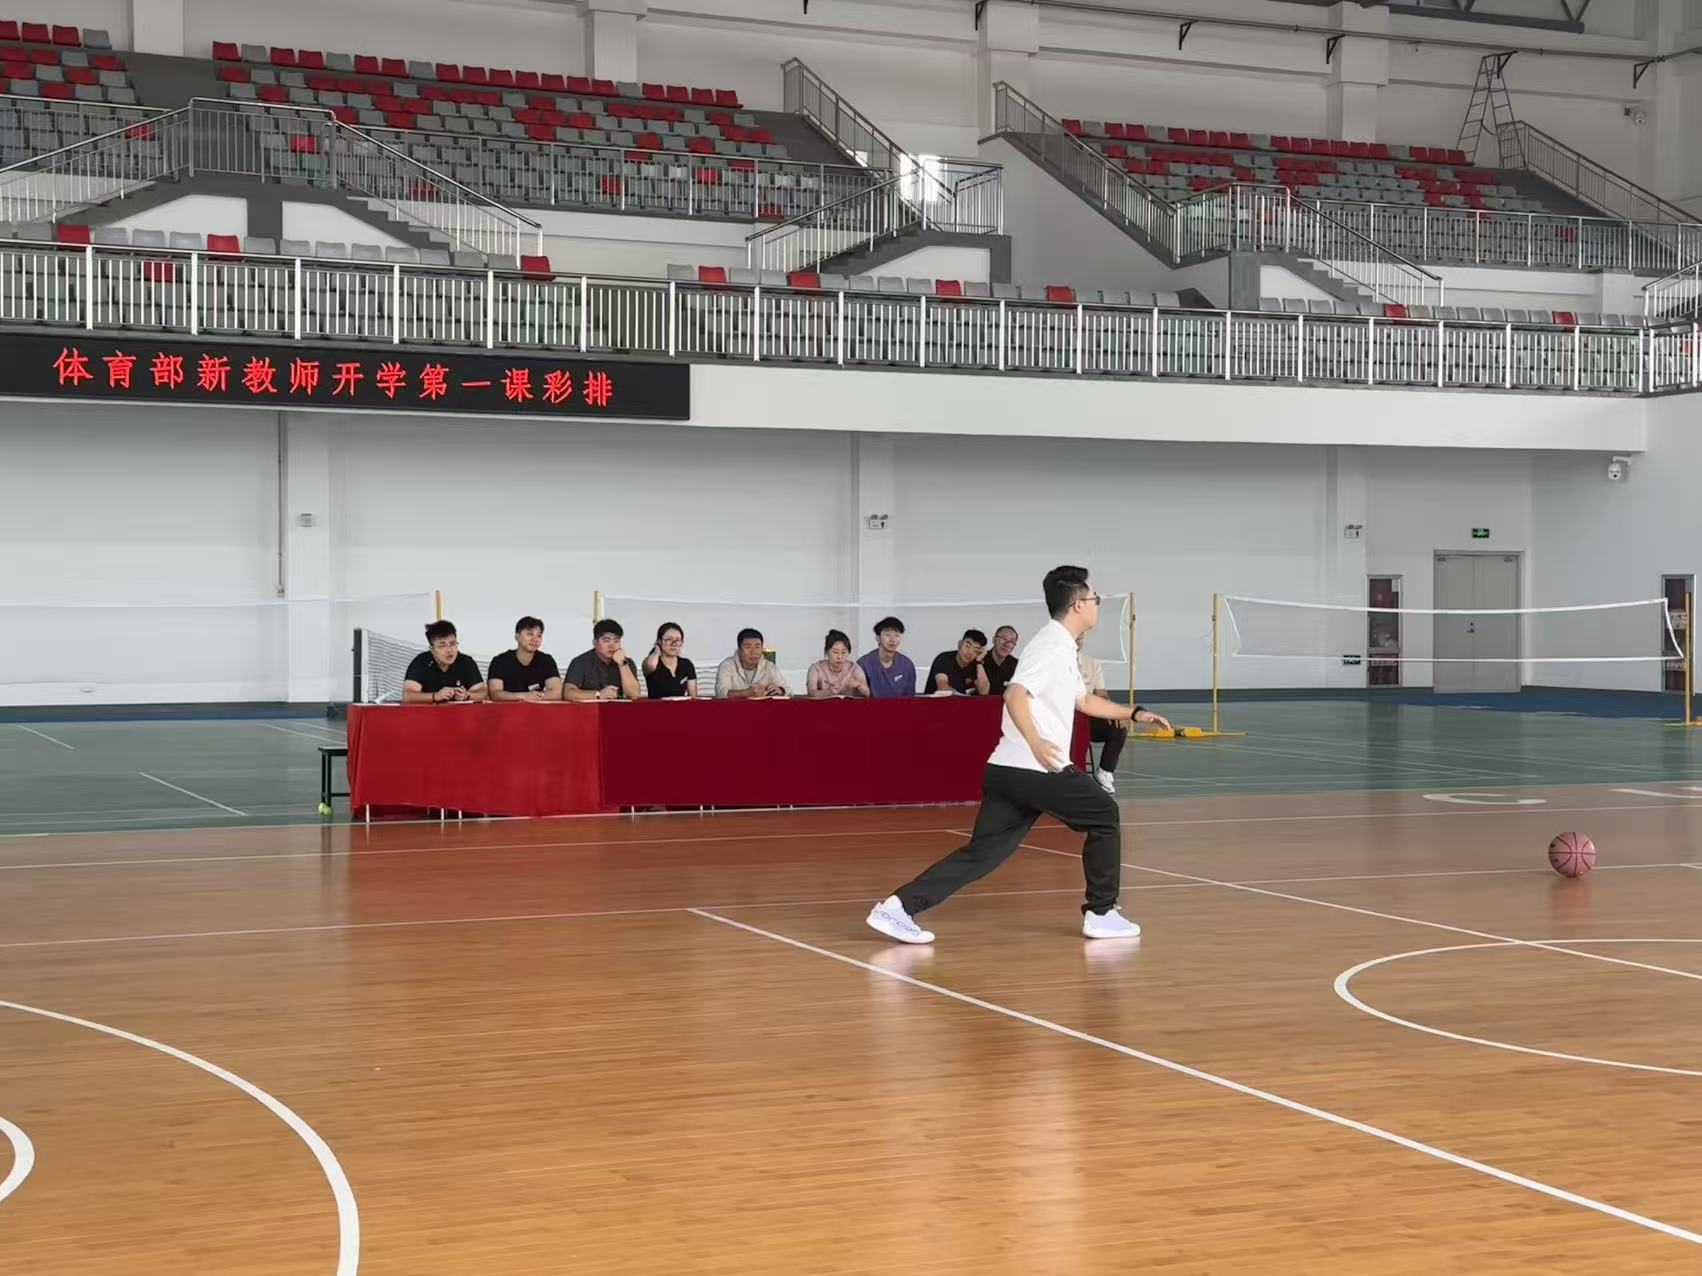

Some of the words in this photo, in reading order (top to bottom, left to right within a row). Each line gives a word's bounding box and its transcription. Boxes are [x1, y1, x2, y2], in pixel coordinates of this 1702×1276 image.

[53, 347, 614, 407] 体育部新教师开学第一课彩排
